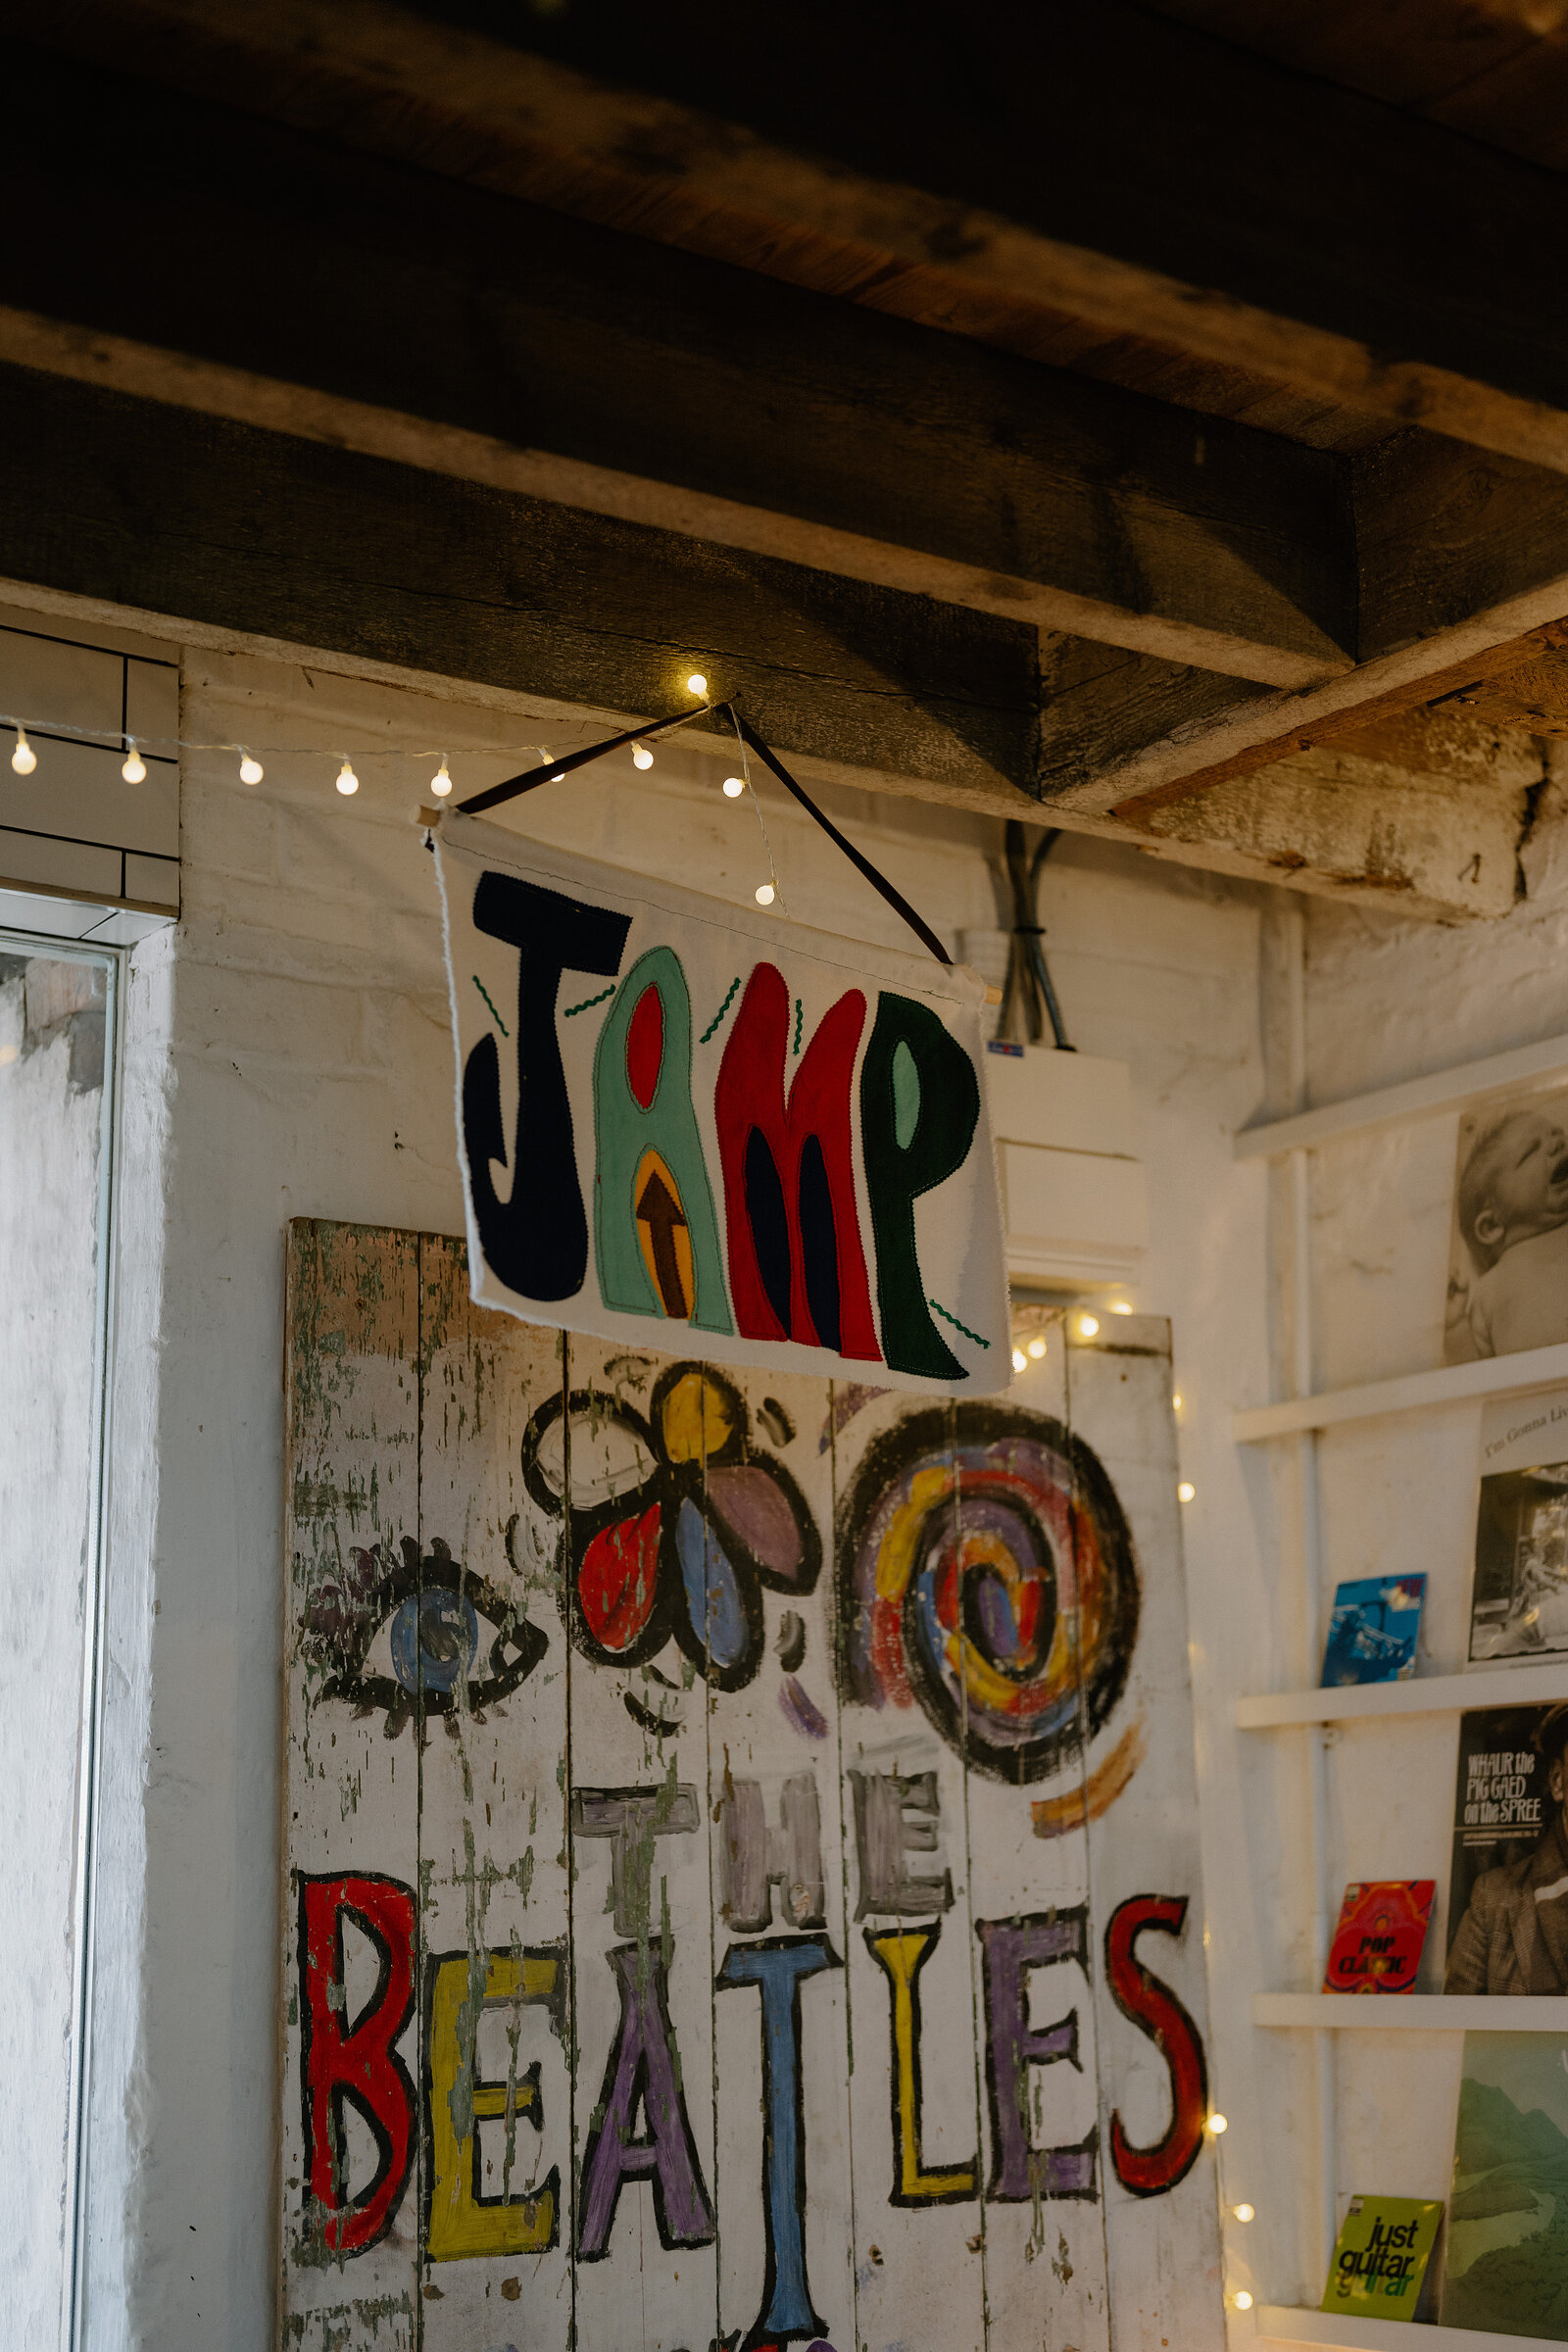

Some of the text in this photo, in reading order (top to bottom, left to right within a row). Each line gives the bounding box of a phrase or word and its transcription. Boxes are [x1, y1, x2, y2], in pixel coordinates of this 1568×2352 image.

[464, 869, 980, 1380] JAMP
[1514, 1750, 1536, 1775] the
[1466, 1775, 1527, 1801] PIG GAED
[1464, 1797, 1543, 1825] on the SPREE
[570, 1768, 956, 1938] THE
[1358, 1936, 1396, 1955] POP
[1339, 1955, 1408, 1975] CLAIC
[291, 1870, 1209, 2342] BEATLES
[1365, 2216, 1419, 2252] just
[1339, 2247, 1416, 2279] guitar
